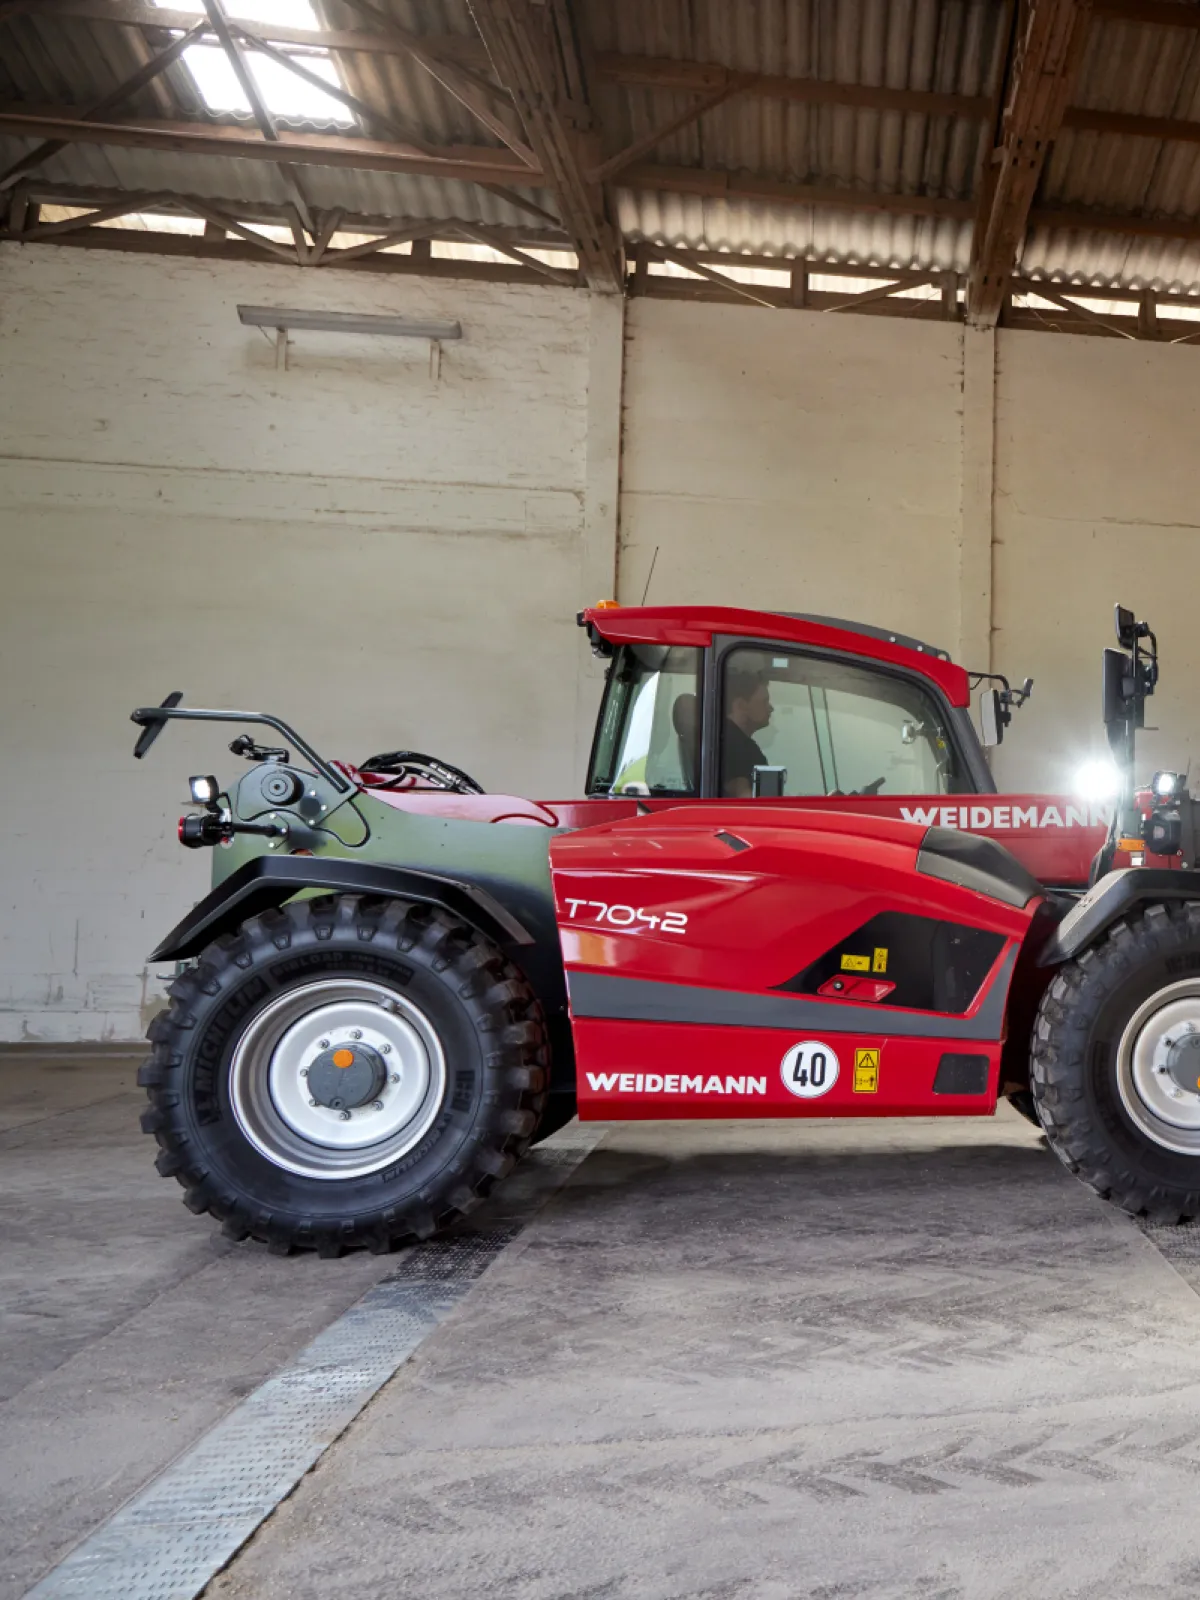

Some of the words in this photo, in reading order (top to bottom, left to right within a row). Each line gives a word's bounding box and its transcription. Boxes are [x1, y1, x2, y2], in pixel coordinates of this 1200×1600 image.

[900, 806, 1117, 829] WEIDEMANN
[564, 897, 688, 934] T7042
[586, 1072, 767, 1095] WEIDEMANN
[792, 1051, 827, 1087] 40
